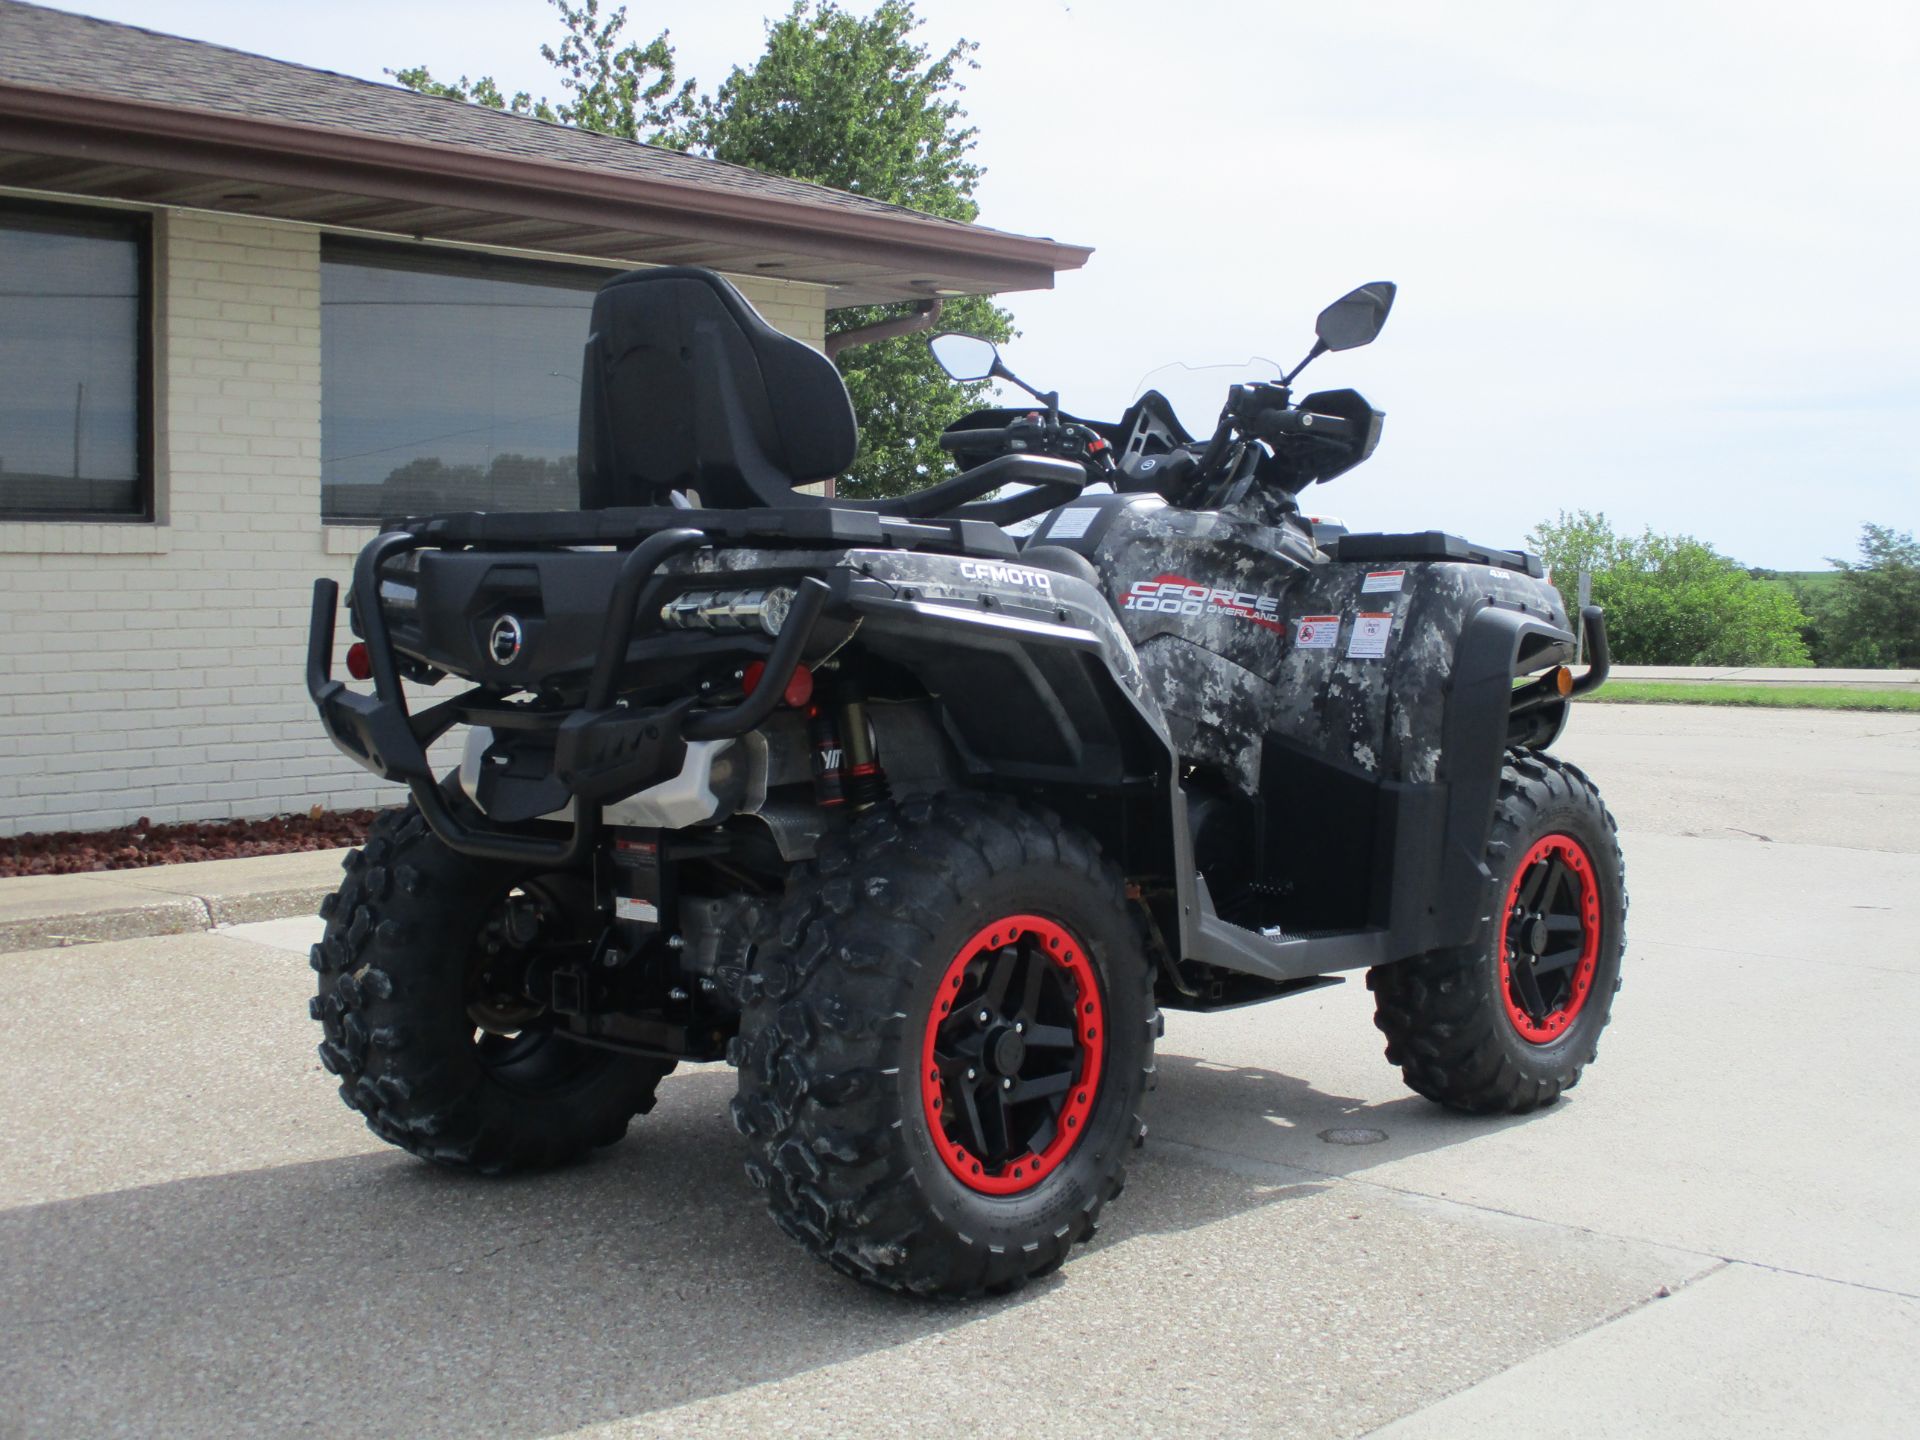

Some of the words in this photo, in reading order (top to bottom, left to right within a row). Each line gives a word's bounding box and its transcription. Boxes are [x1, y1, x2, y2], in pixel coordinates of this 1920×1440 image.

[960, 562, 1050, 588] CFMOTO
[1124, 596, 1204, 616] 1000
[1206, 604, 1279, 622] OVERLAND
[1130, 581, 1279, 611] CFORCE
